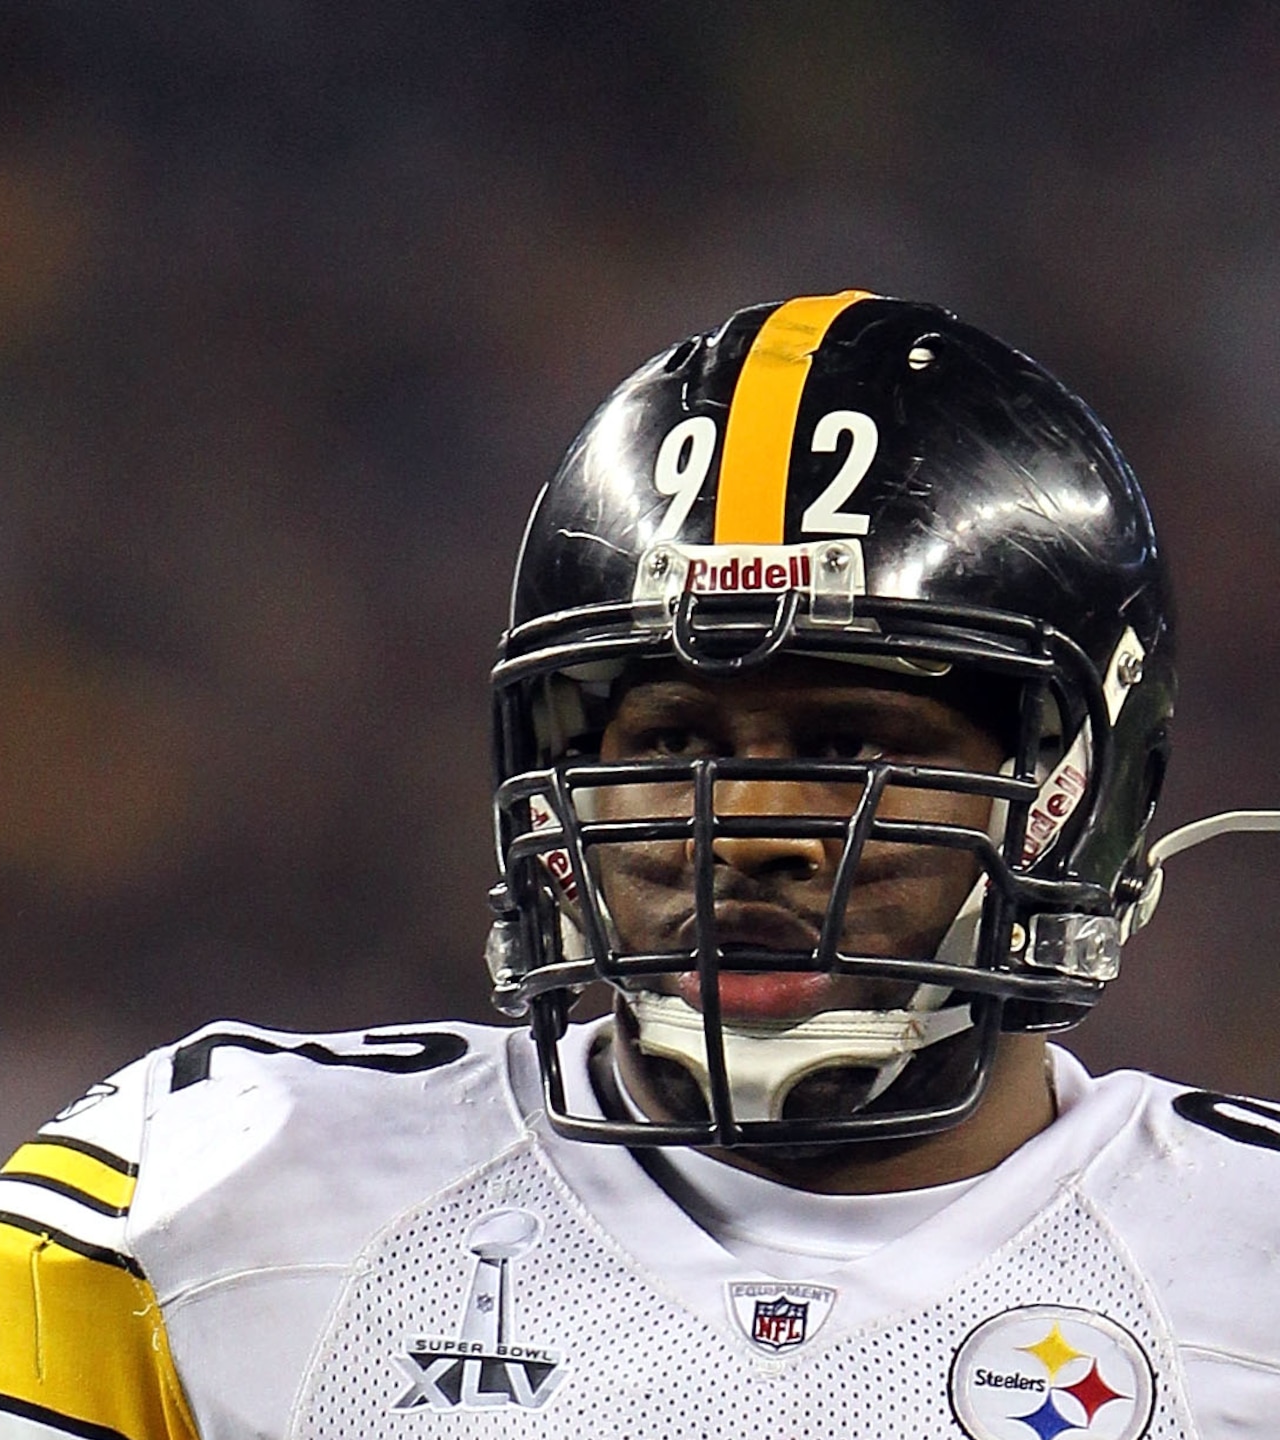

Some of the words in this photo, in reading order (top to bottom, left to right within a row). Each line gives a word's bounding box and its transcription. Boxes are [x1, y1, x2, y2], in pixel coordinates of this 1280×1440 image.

[655, 416, 717, 546] 9
[801, 410, 879, 535] 2
[684, 551, 811, 592] Riddell
[754, 1315, 802, 1342] NFL
[415, 1338, 484, 1354] SUPER
[496, 1345, 553, 1362] BOWL
[392, 1354, 571, 1410] XLV
[974, 1368, 1046, 1393] Steelers
